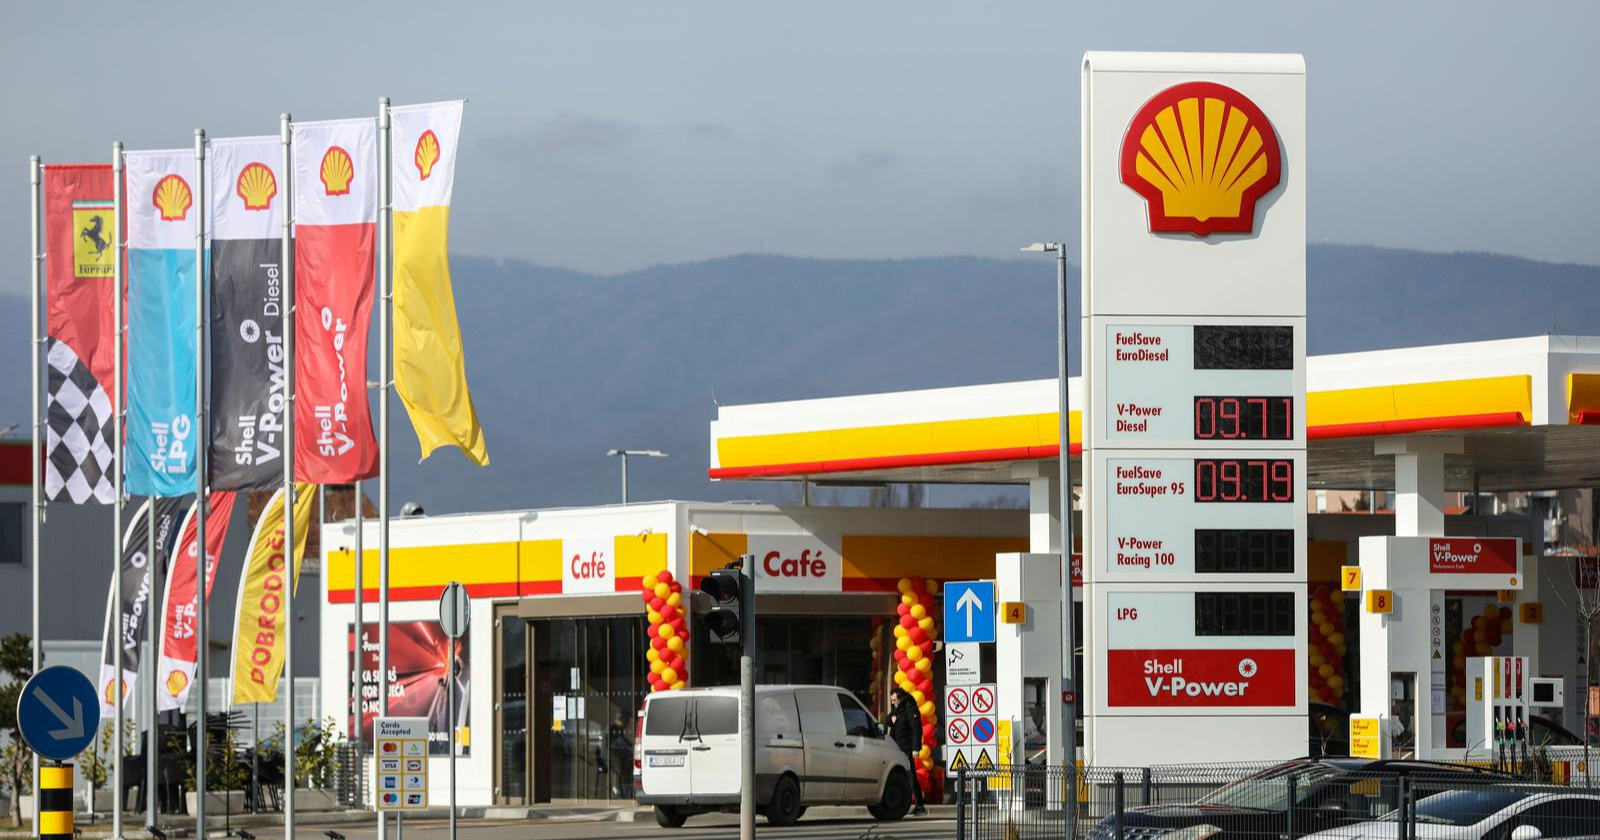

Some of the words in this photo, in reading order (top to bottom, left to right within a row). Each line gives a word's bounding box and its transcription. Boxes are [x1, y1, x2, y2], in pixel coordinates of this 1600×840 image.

[260, 263, 280, 317] Diesel
[1116, 332, 1161, 345] FuelSave
[1116, 349, 1169, 362] EuroDiesel
[333, 317, 355, 456] V-Power
[255, 330, 284, 466] V-Power
[1117, 403, 1162, 416] V-Power
[1195, 398, 1291, 438] 09.71
[315, 405, 335, 457] Shell
[1116, 420, 1147, 432] Diesel
[151, 422, 169, 474] Shell
[168, 414, 191, 473] LPG
[235, 415, 257, 466] Shell
[1116, 466, 1162, 479] FuelSave
[1196, 461, 1292, 501] 09.79
[1116, 482, 1167, 497] EuroSuper
[1171, 482, 1185, 495] 95
[1117, 537, 1162, 550] V-Power
[1433, 543, 1451, 551] Shell
[763, 549, 827, 577] Café
[1117, 553, 1150, 568] Racing
[1154, 553, 1175, 565] 100
[1434, 552, 1478, 562] V-Power
[571, 551, 606, 579] Café
[1349, 572, 1357, 584] 7
[1378, 596, 1386, 608] 8
[1012, 607, 1019, 619] 4
[1117, 608, 1138, 620] LPG
[1529, 607, 1537, 618] 2
[174, 604, 184, 638] Shell
[1143, 659, 1183, 674] Shell
[1144, 677, 1249, 696] V-Power
